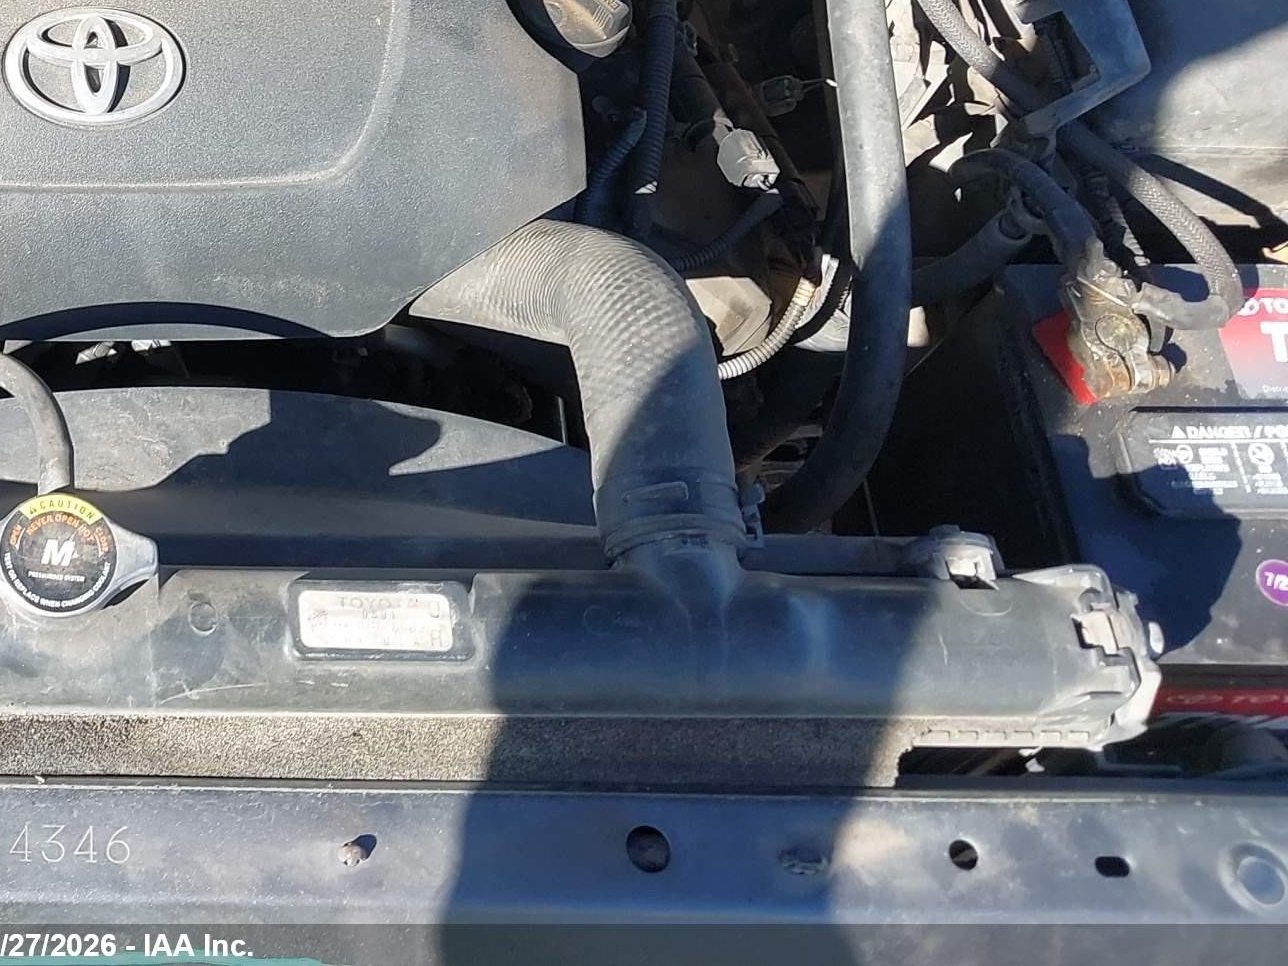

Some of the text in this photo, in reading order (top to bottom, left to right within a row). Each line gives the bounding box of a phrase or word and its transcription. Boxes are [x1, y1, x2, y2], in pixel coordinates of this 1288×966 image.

[39, 498, 96, 520] CAUTION
[9, 523, 23, 546] OPEN
[26, 512, 95, 542] NEVER OPEN HOT
[13, 577, 41, 604] REPLACE
[92, 561, 111, 592] COOLANT
